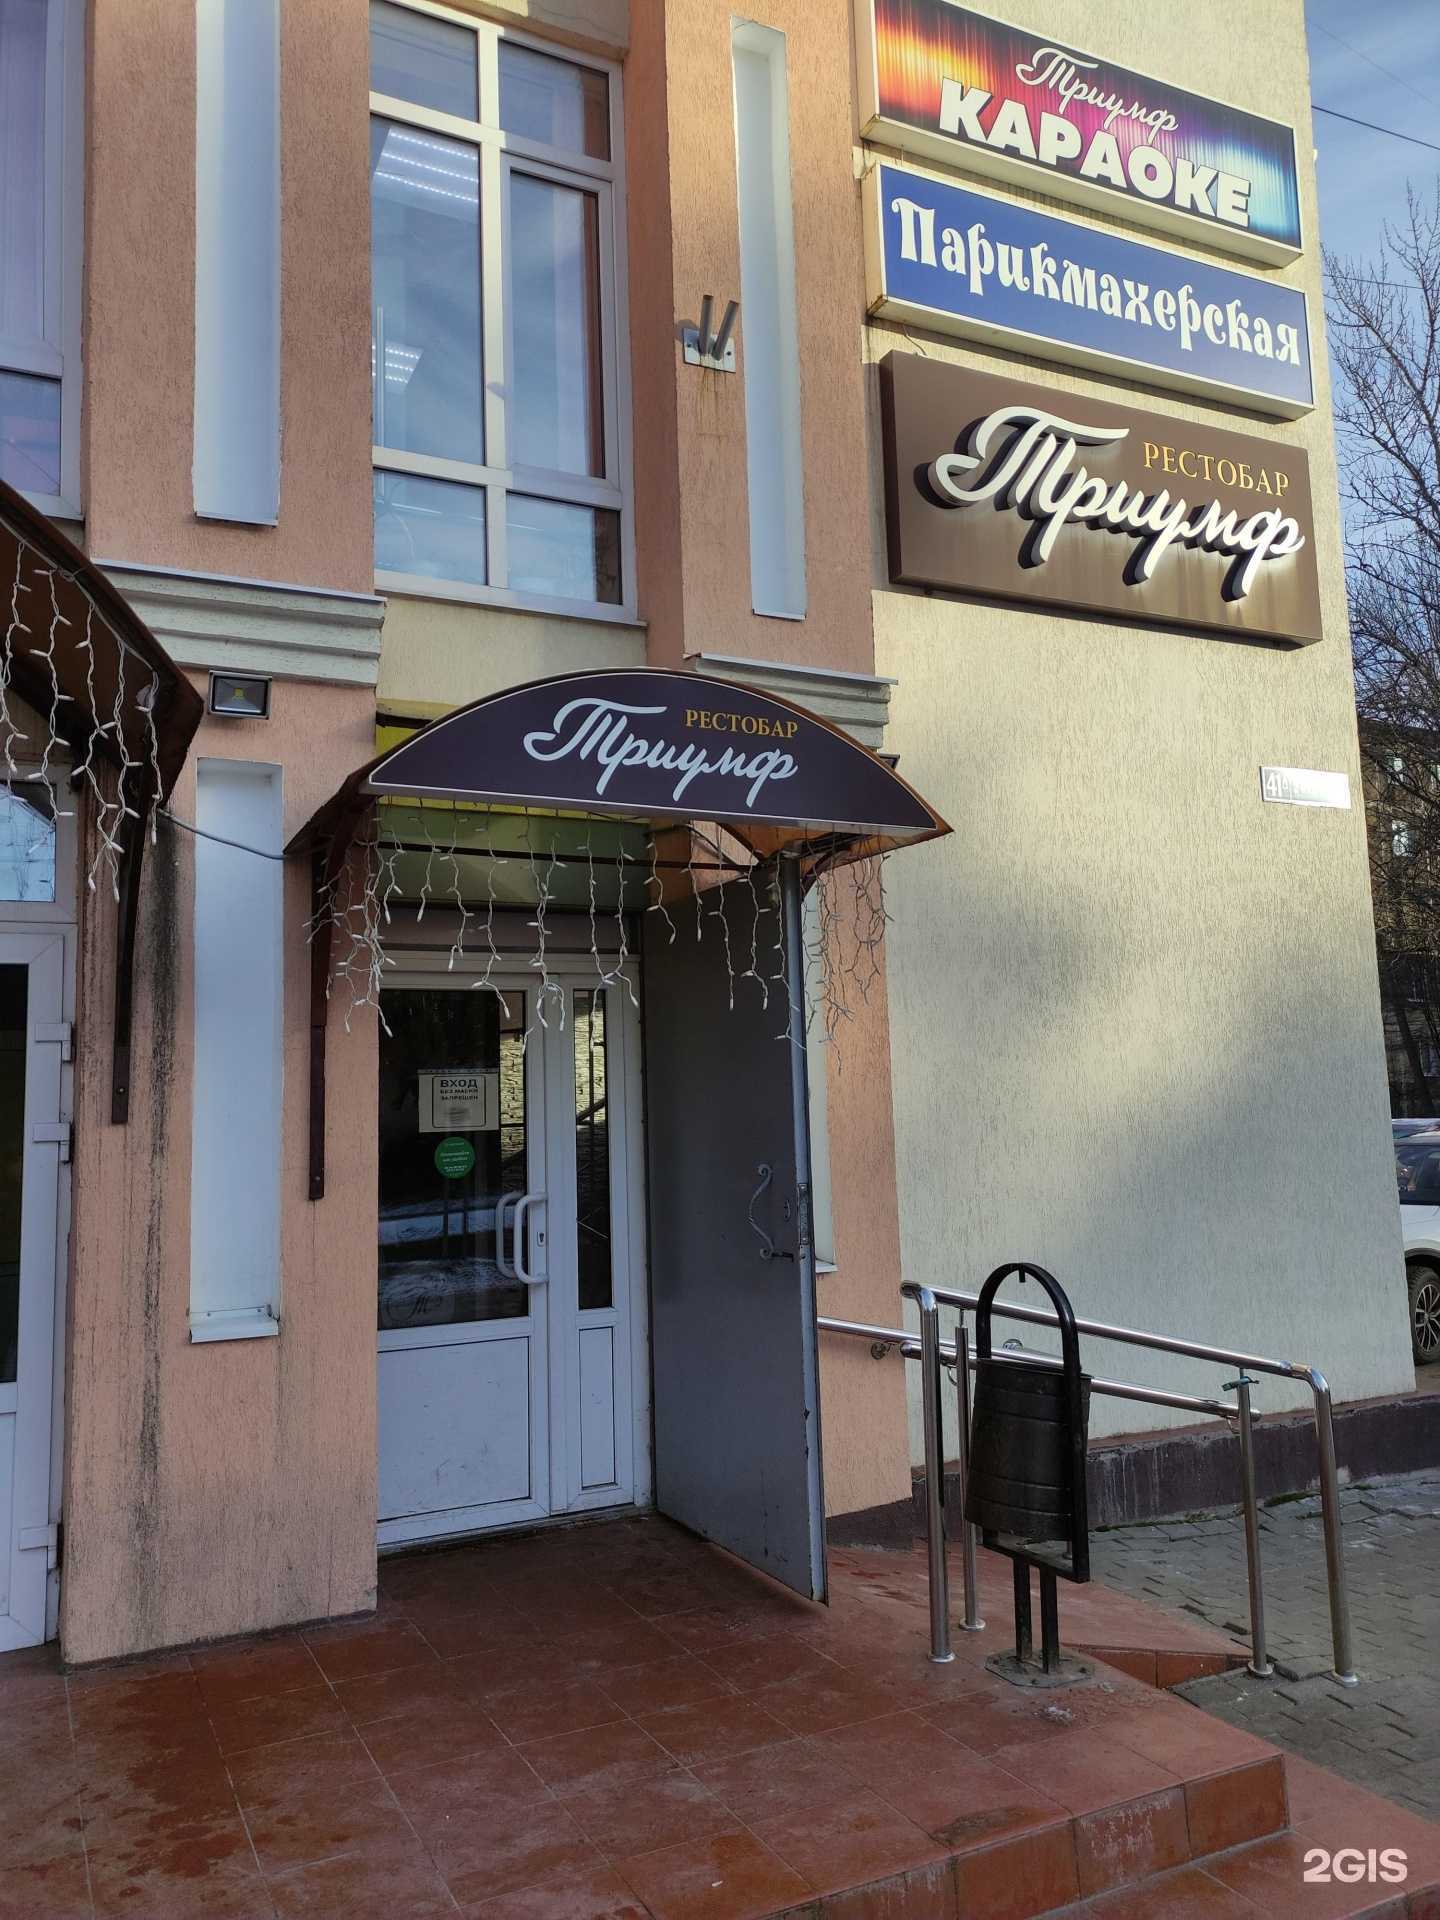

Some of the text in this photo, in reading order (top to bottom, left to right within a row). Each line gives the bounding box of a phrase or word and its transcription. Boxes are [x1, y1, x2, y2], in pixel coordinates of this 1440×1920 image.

[1015, 47, 1179, 143] Триумф
[939, 76, 1252, 228] КАРАОКЕ
[891, 197, 1300, 366] Парикмахерская
[931, 406, 1305, 599] Триумф
[1143, 441, 1289, 497] РЕСТОБАР
[523, 697, 798, 808] Триумф
[685, 709, 798, 738] РЕСТОБАР
[440, 1079, 478, 1088] ВХОД
